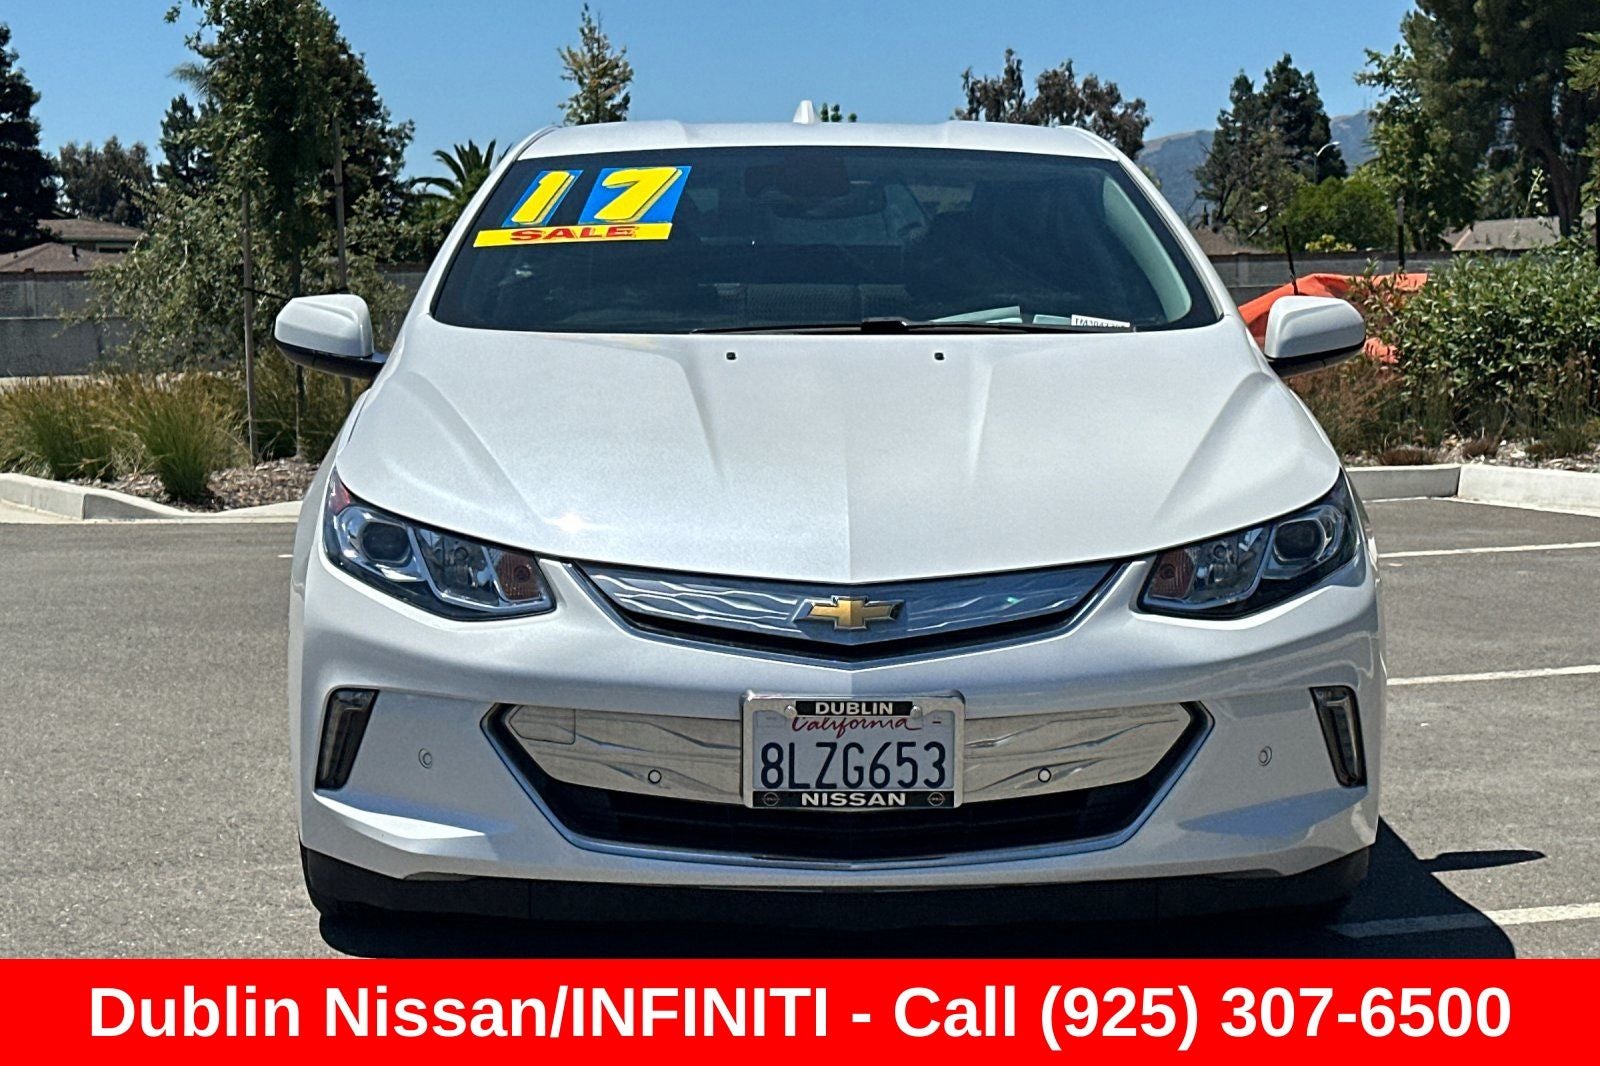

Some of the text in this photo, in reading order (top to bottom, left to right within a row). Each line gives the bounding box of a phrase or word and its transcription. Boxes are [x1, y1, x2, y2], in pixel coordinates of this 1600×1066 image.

[511, 167, 683, 224] 17
[510, 225, 639, 242] SALE
[815, 702, 893, 715] DUBLIN
[791, 717, 923, 739] California
[760, 741, 946, 790] 8LZG653
[801, 792, 906, 807] NISSAN
